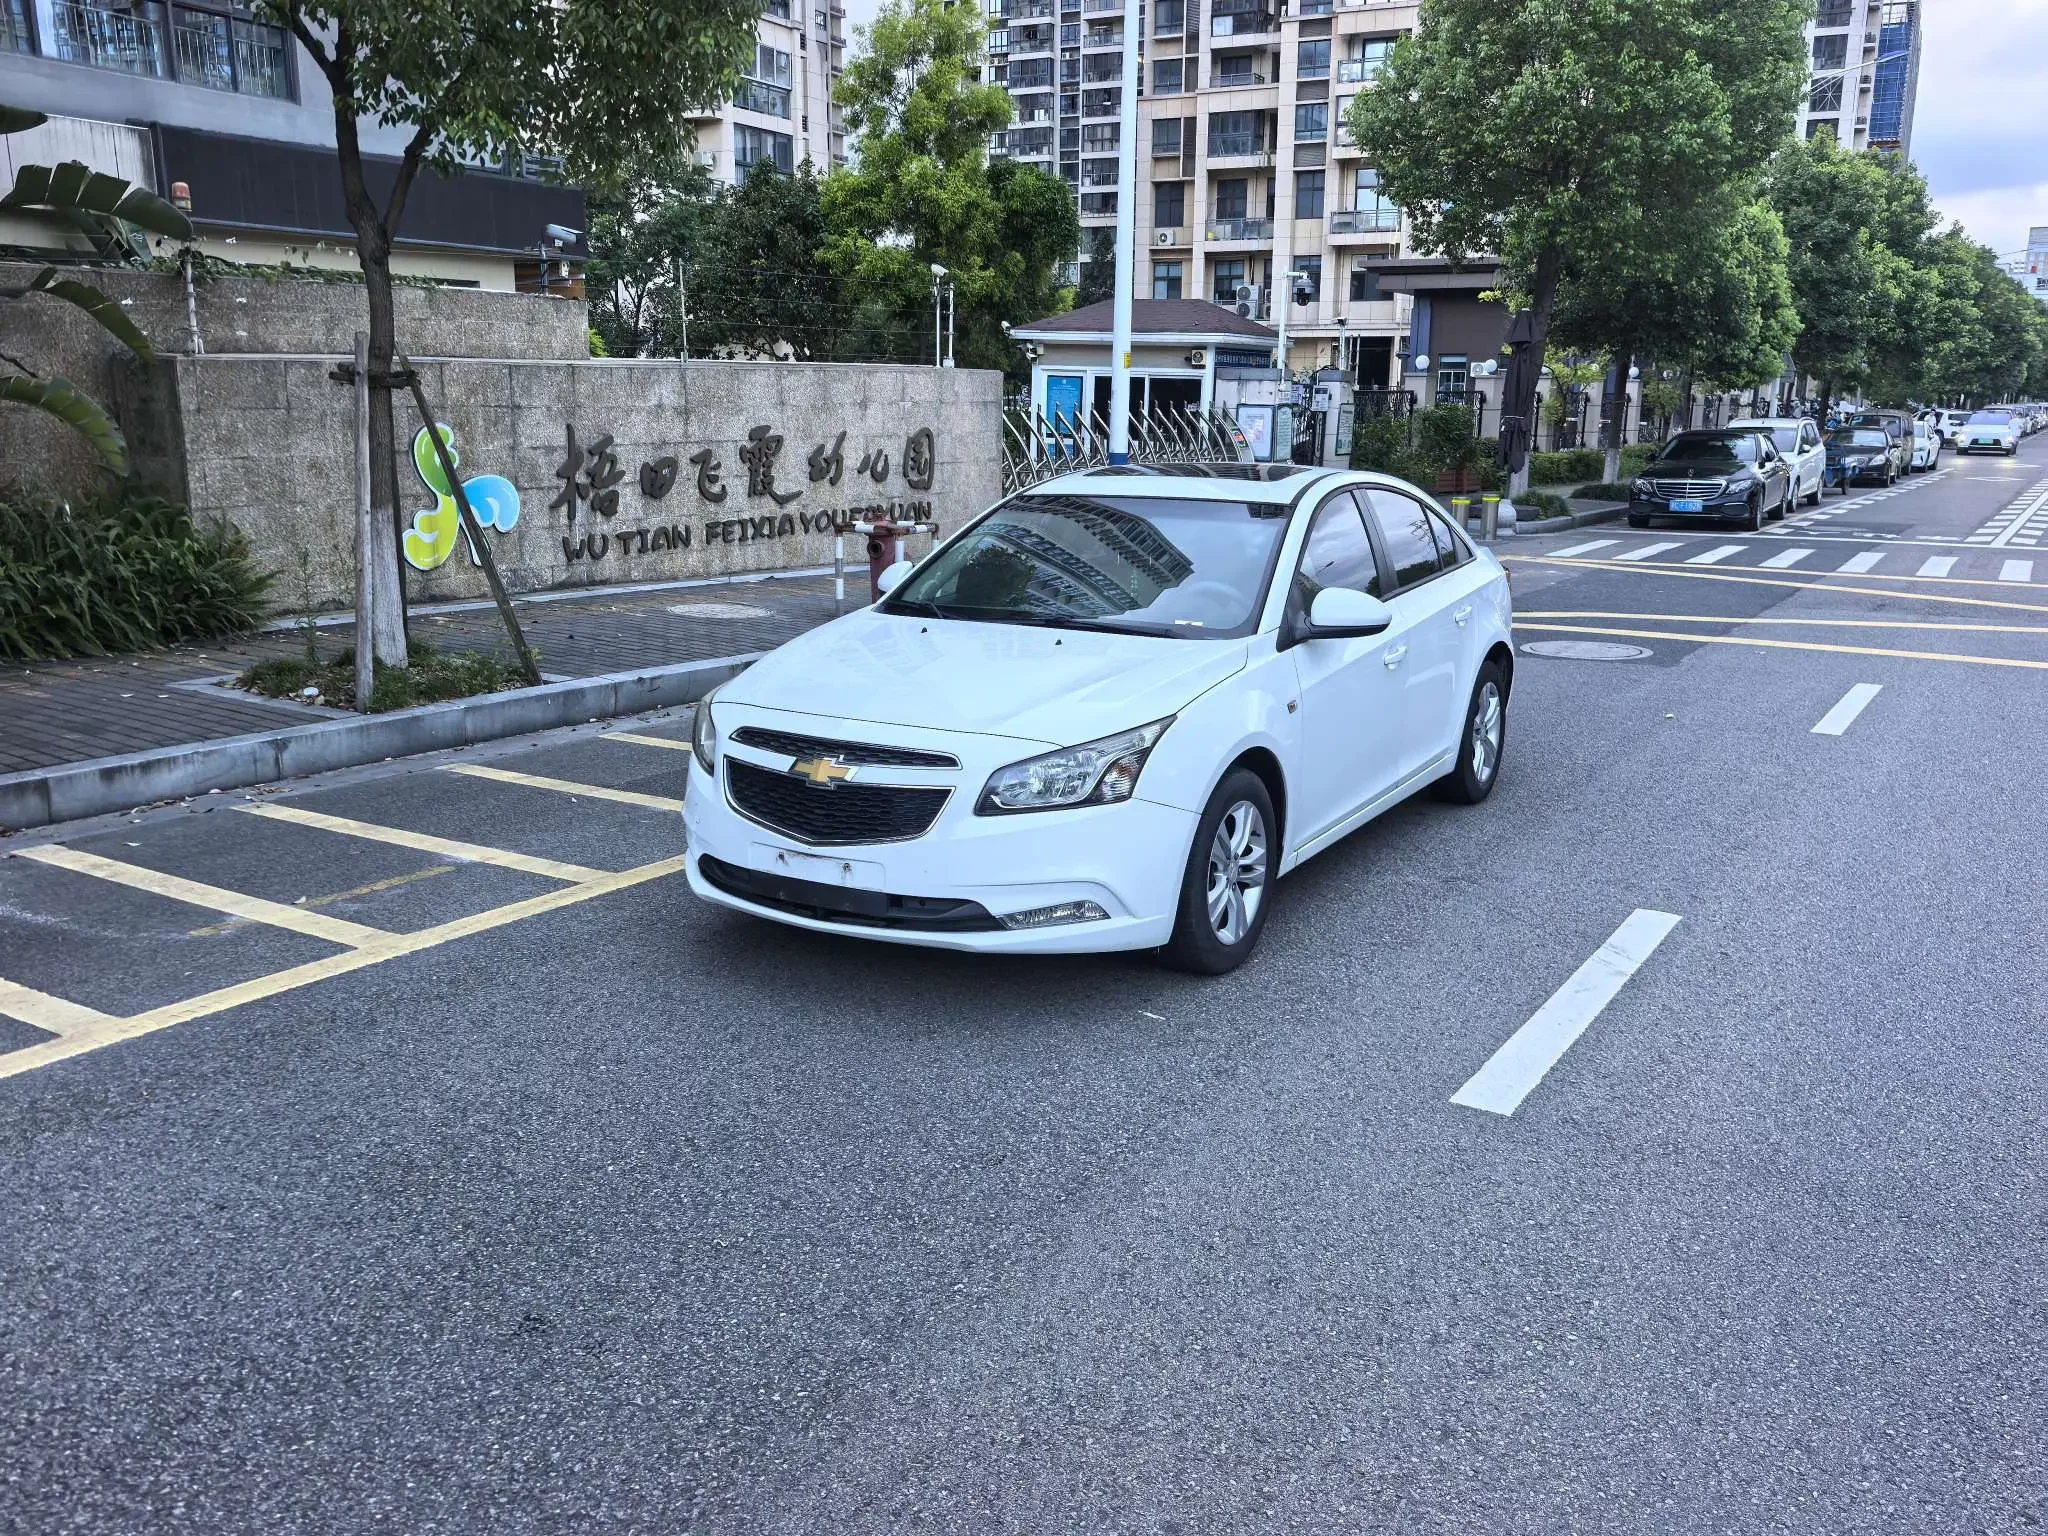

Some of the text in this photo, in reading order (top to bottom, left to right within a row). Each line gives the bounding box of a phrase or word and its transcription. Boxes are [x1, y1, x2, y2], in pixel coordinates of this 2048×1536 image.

[562, 533, 609, 563] WU
[615, 524, 691, 557] TIAN
[704, 512, 796, 546] FEIXIA
